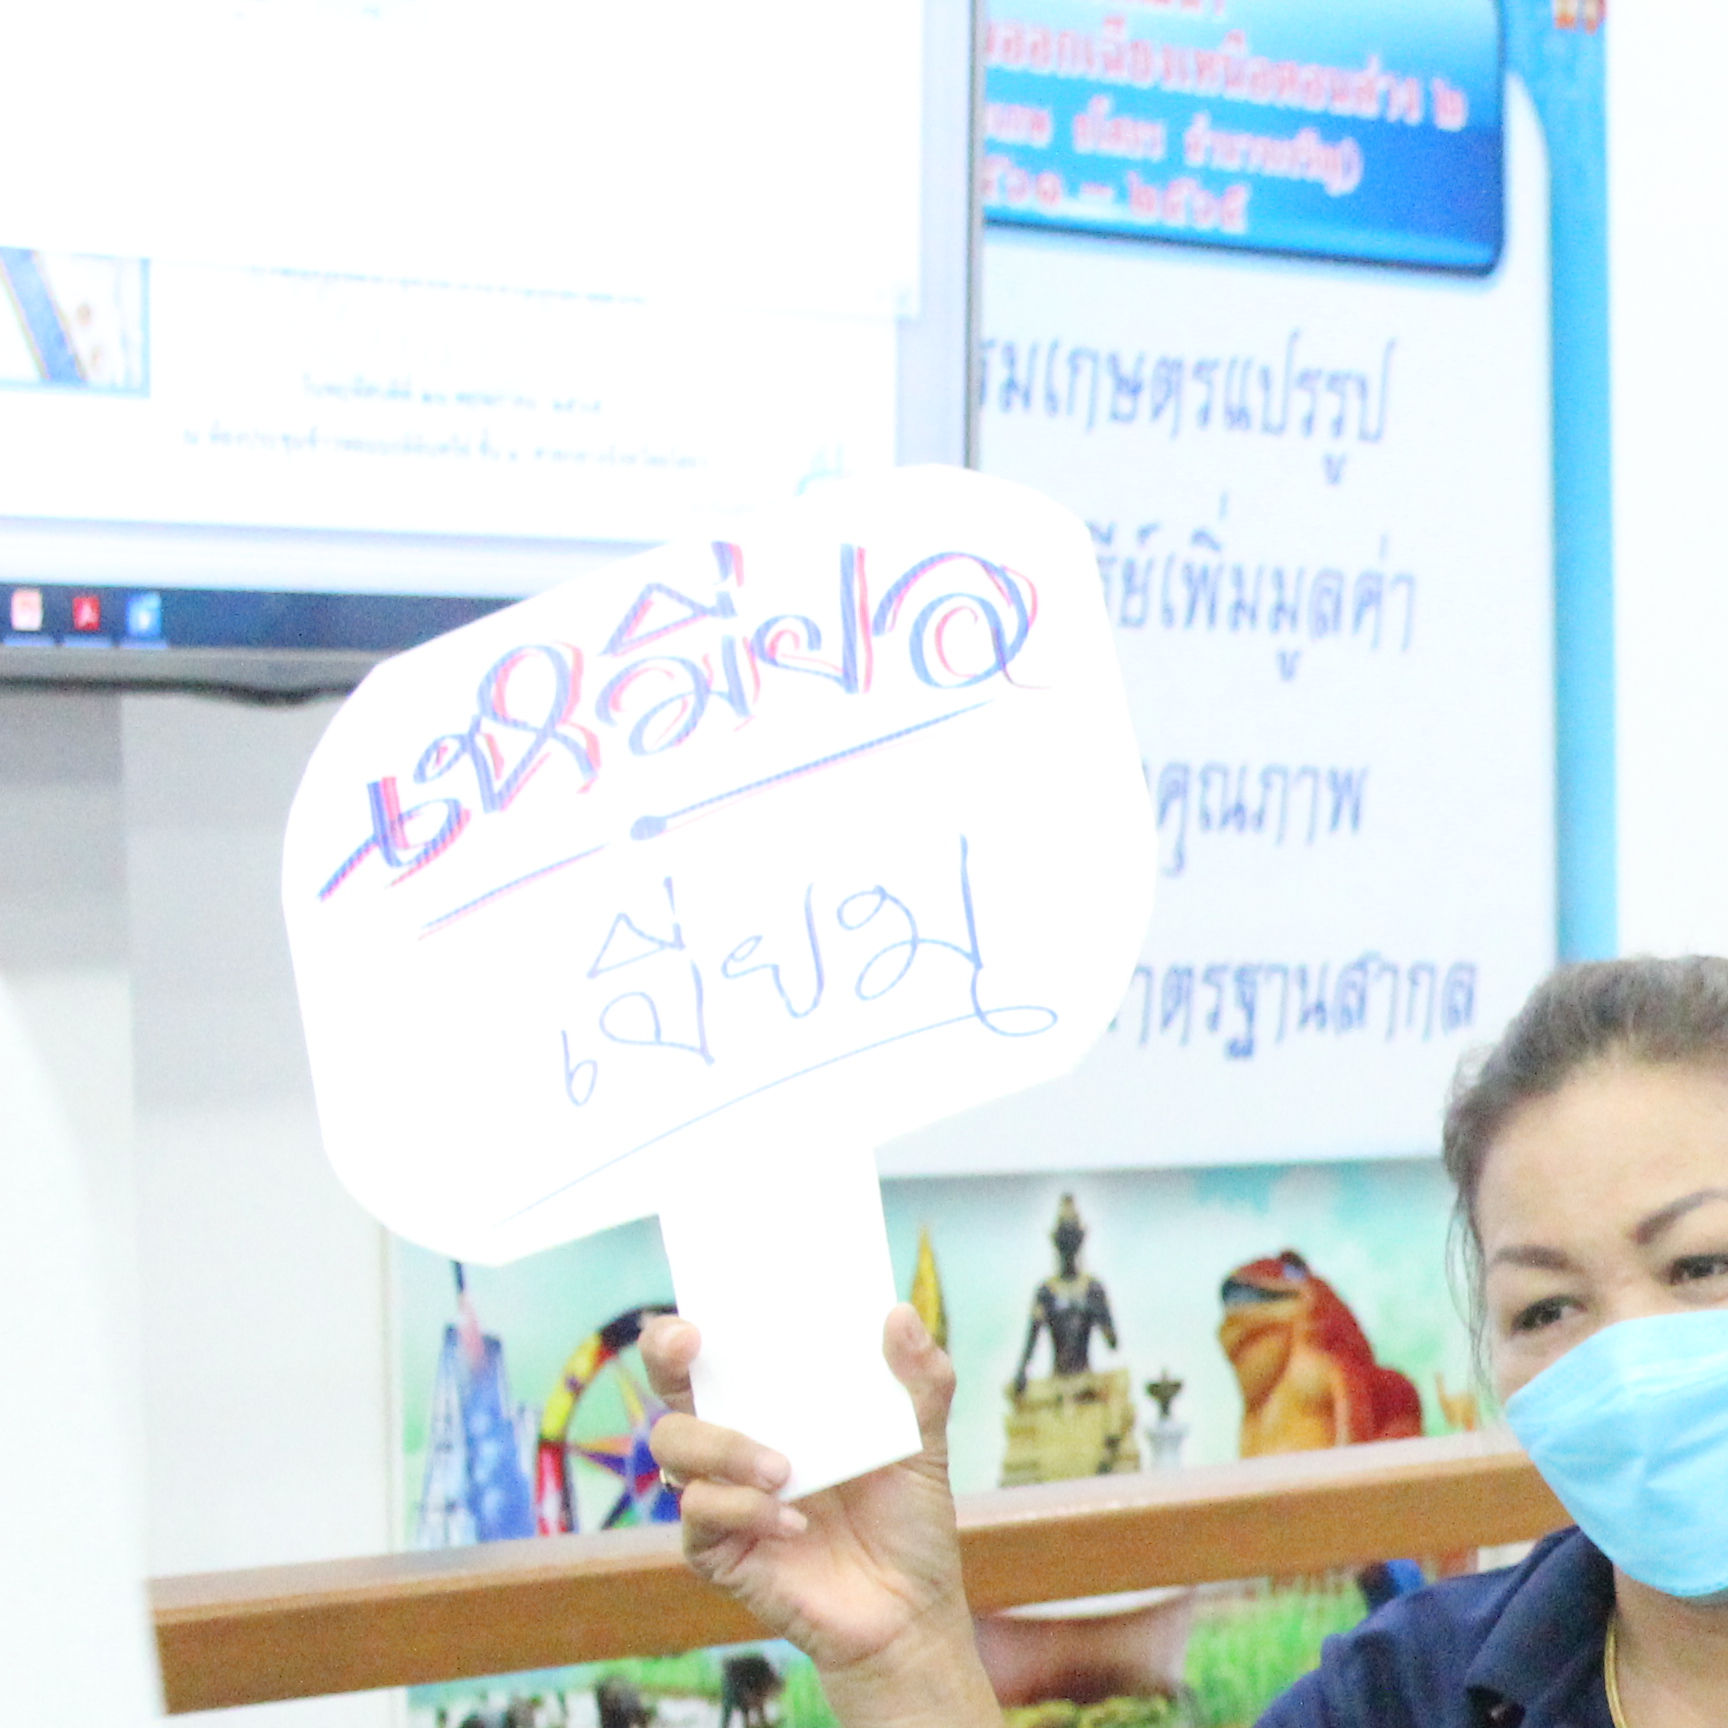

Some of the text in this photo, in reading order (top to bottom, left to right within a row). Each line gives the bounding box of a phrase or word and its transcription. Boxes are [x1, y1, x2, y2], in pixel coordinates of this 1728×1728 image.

[1143, 759, 1371, 878] คุณภาพ
[1116, 949, 1479, 1061] าตรฐานสากล
